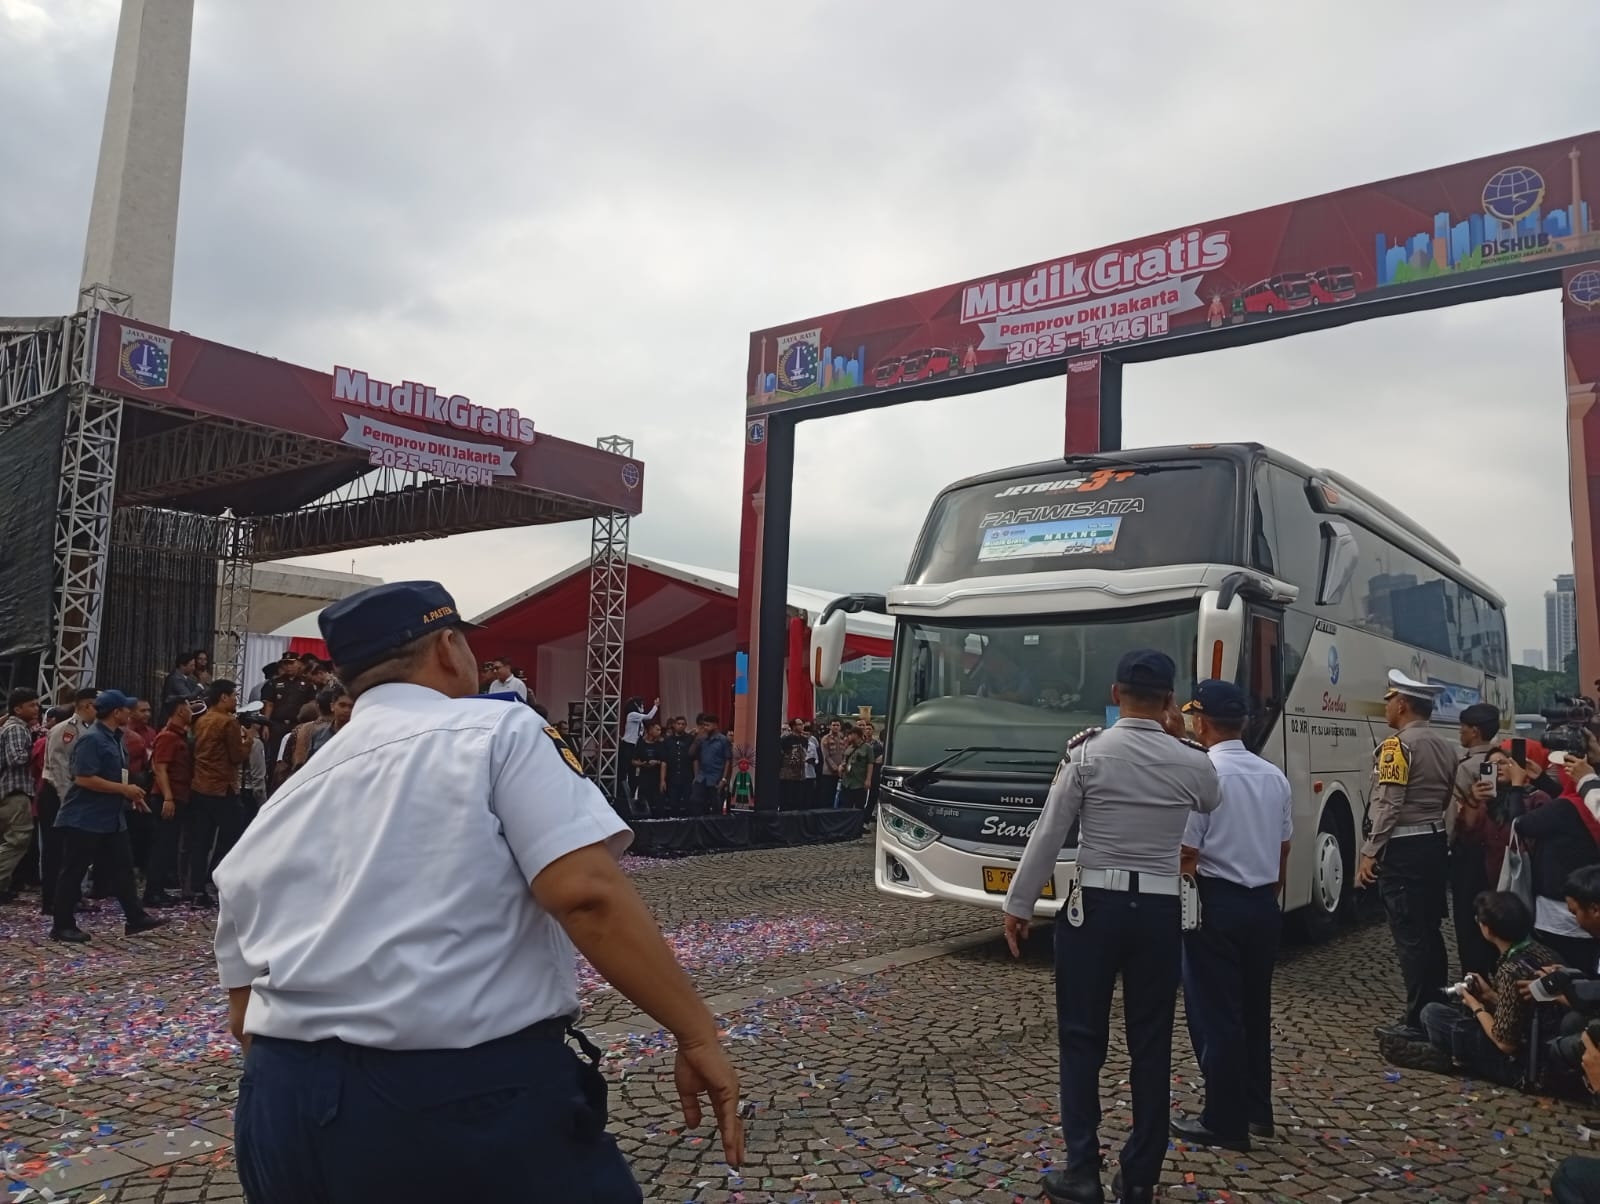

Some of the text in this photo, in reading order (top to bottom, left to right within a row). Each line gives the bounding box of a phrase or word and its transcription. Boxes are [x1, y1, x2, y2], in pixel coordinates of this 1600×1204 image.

[1481, 232, 1550, 258] DISHUB
[961, 230, 1231, 322] Mudik Gratis
[1000, 288, 1179, 337] Pemprov DKI Jakarta
[127, 329, 145, 338] JAYA
[782, 335, 798, 344] JAYA
[1007, 332, 1067, 363] 2025
[1081, 315, 1147, 349] 1446
[1148, 312, 1169, 337] H
[332, 365, 535, 445] Mudik Gratis
[362, 424, 501, 466] Pemprov DKI Jakarta
[369, 446, 420, 472] 2025
[432, 459, 479, 484] 1446
[480, 470, 493, 486] H
[994, 478, 1087, 497] JETBUS
[978, 497, 1145, 529] PARIWISATA
[1043, 530, 1098, 541] MALANG
[1291, 719, 1308, 734] 02 XR
[1379, 765, 1400, 781] SATGAS
[1000, 796, 1034, 804] HINO
[986, 870, 994, 882] B
